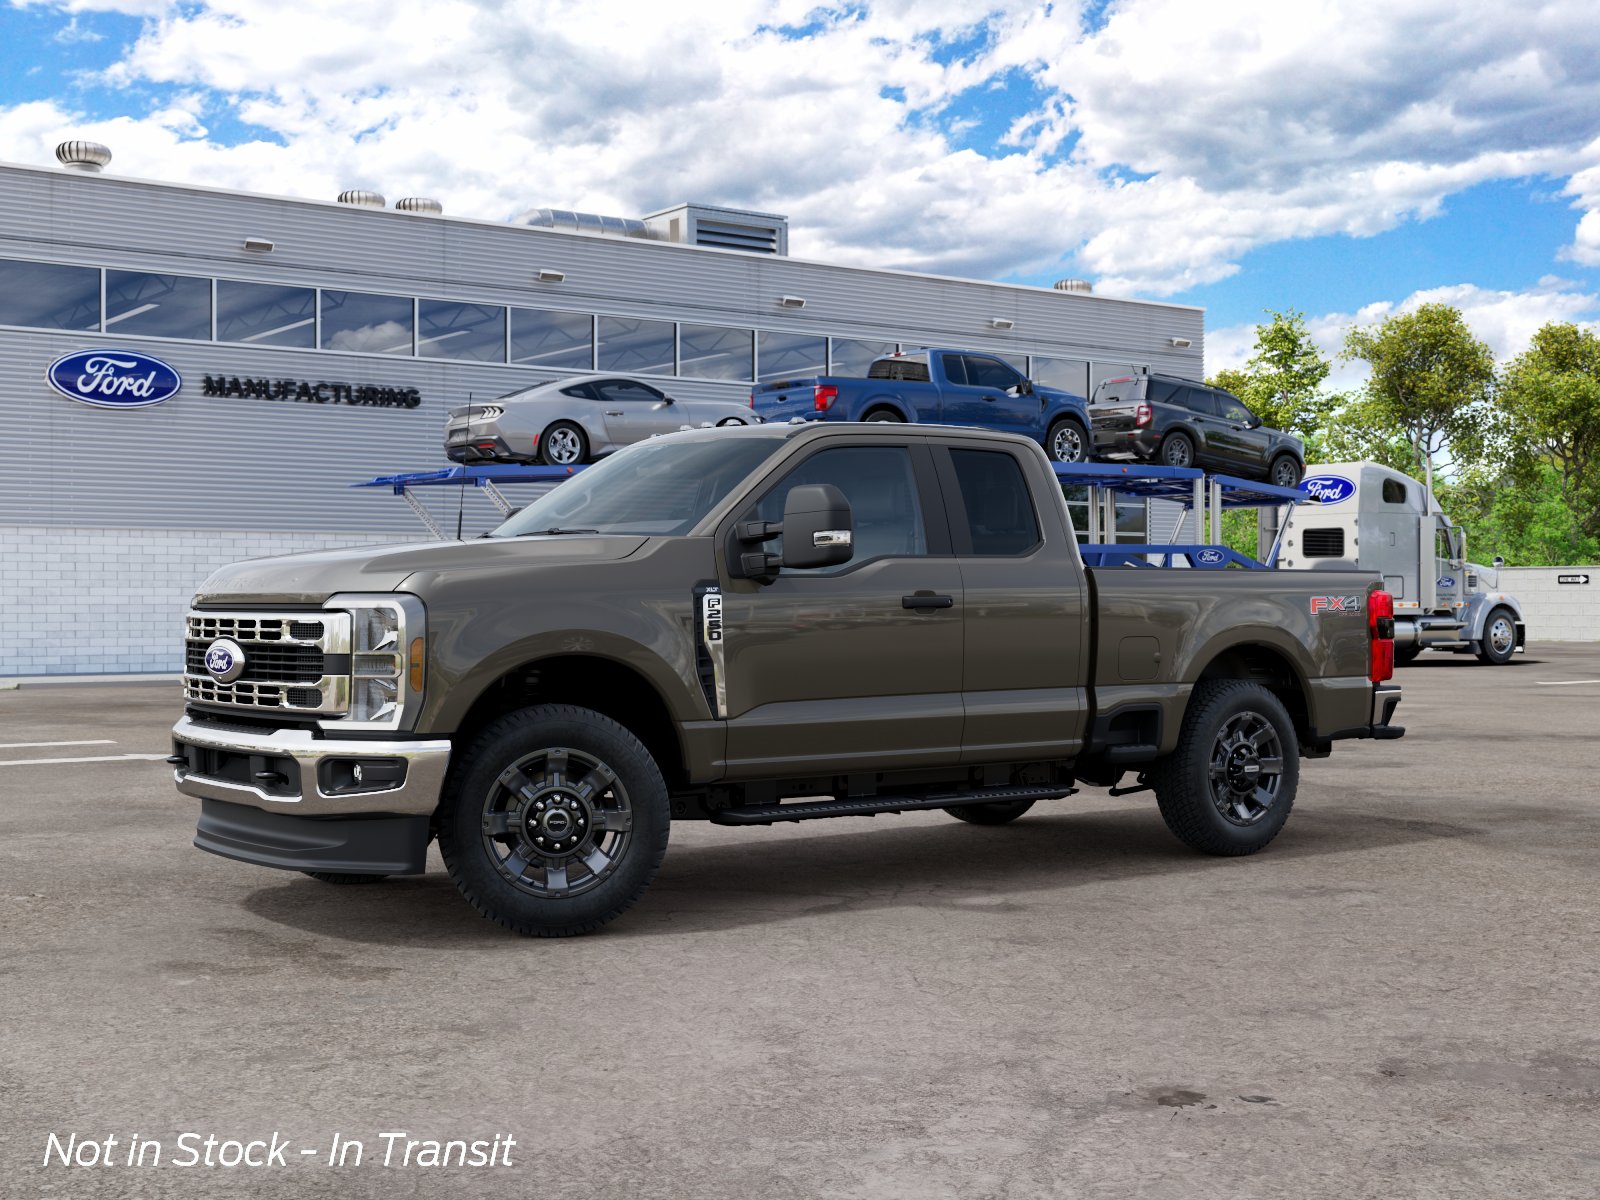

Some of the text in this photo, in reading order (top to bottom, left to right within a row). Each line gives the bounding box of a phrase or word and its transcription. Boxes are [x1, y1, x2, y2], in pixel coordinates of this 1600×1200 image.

[77, 357, 156, 397] Ford
[202, 374, 421, 408] MANUFACTURING
[1305, 480, 1343, 500] Ford
[1201, 550, 1219, 562] Ford
[1310, 596, 1361, 616] FX4
[210, 650, 229, 670] Ford
